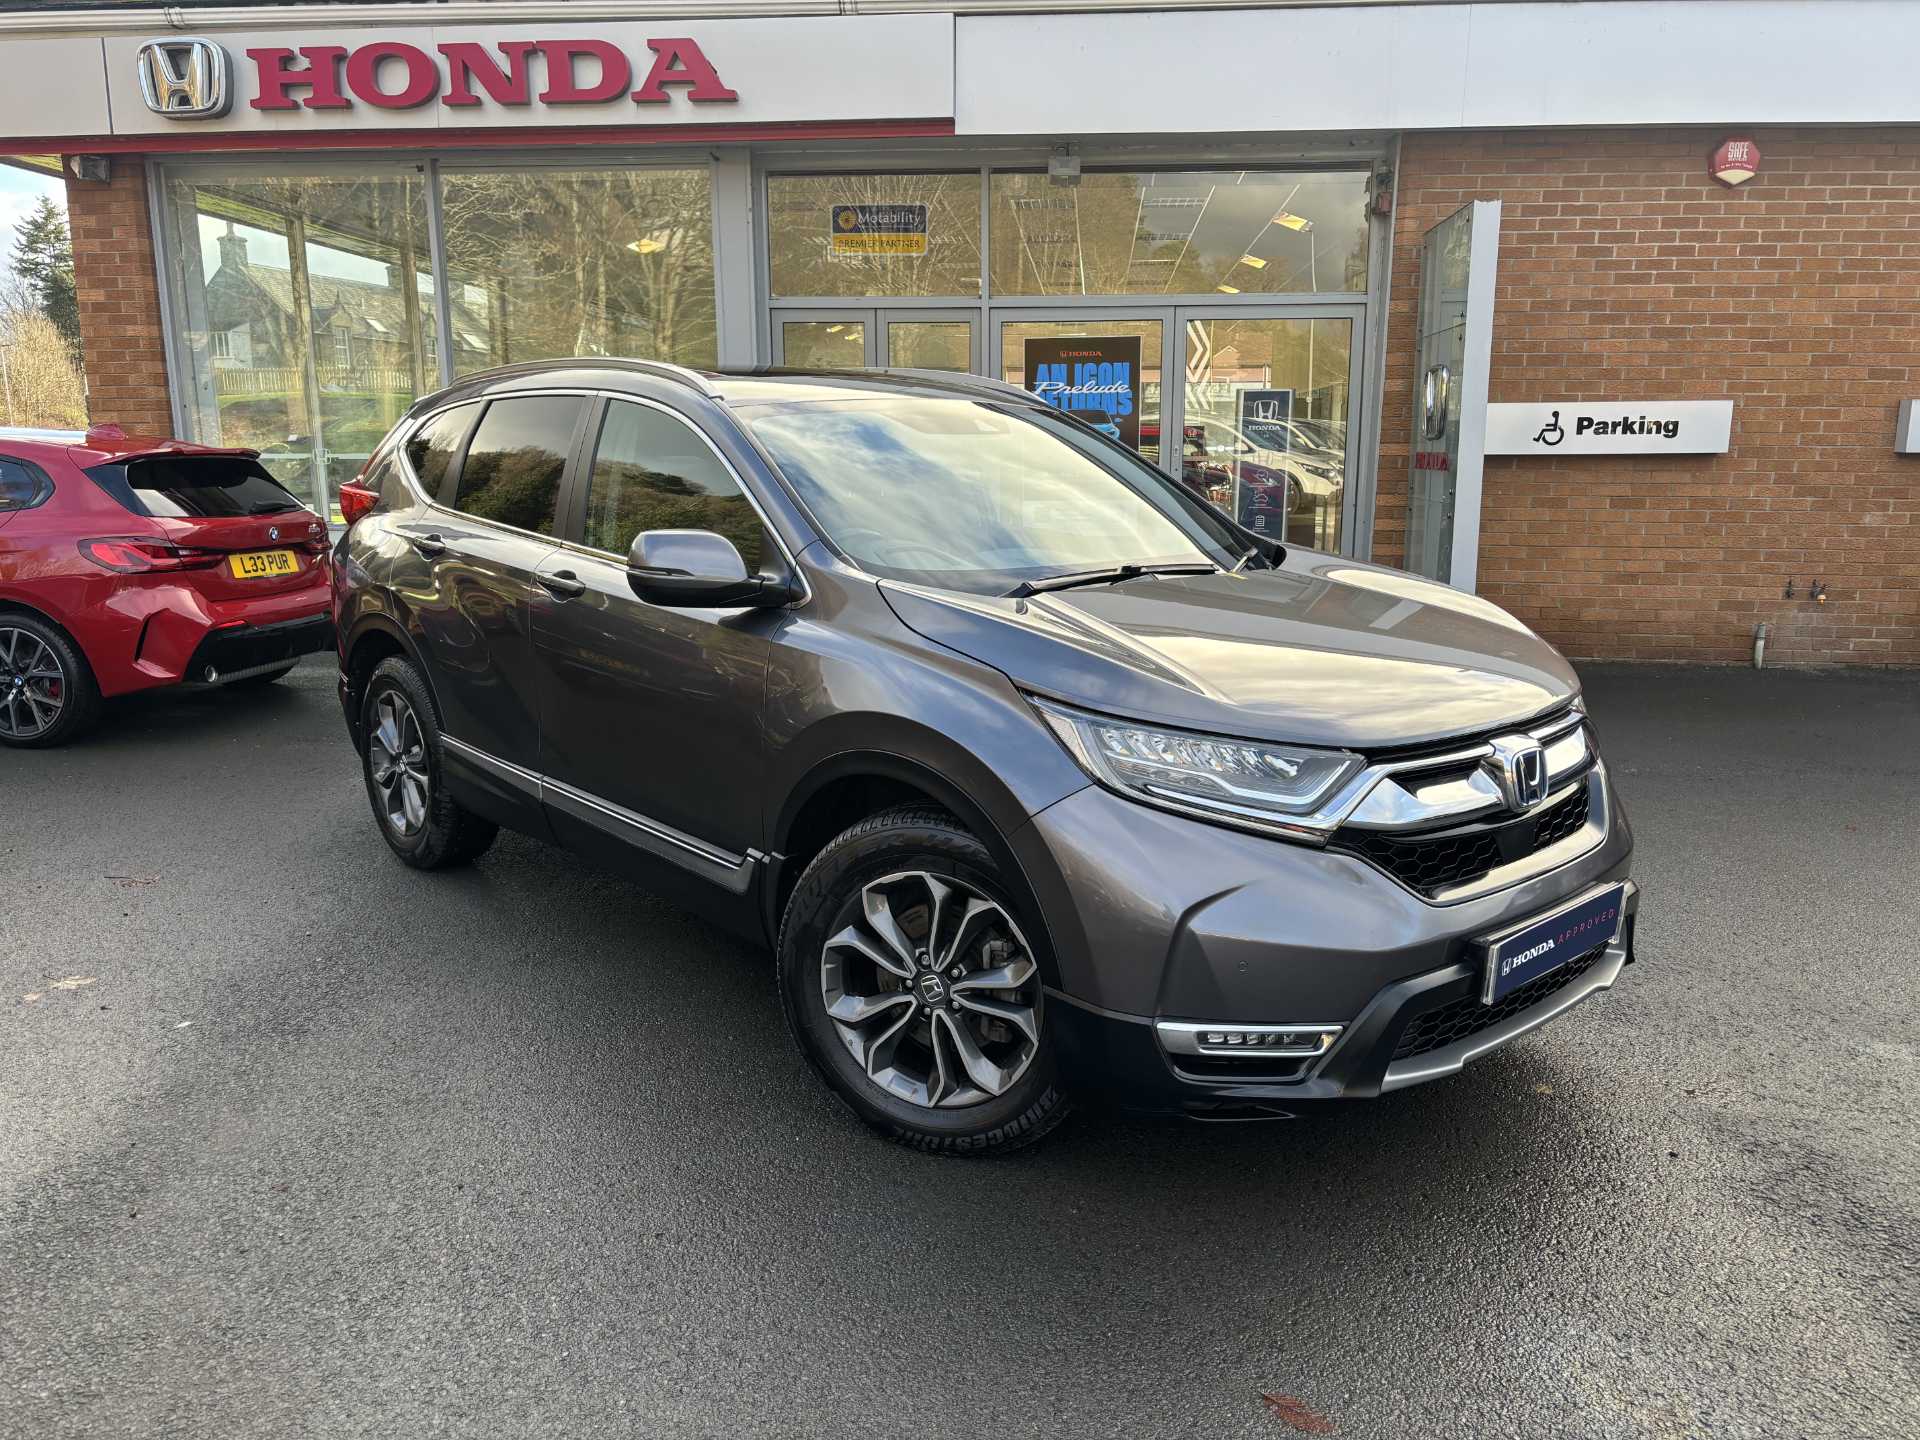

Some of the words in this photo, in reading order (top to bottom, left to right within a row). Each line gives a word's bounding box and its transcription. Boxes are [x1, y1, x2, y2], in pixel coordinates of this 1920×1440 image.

[246, 38, 738, 110] HONDA
[858, 212, 921, 225] Motability
[1074, 362, 1130, 387] ICON
[1032, 380, 1131, 394] Prelude
[1576, 415, 1679, 438] Parking
[240, 556, 266, 573] L33
[266, 553, 291, 570] PUR
[1511, 939, 1556, 968] HONDA
[1557, 908, 1617, 945] APPROVED
